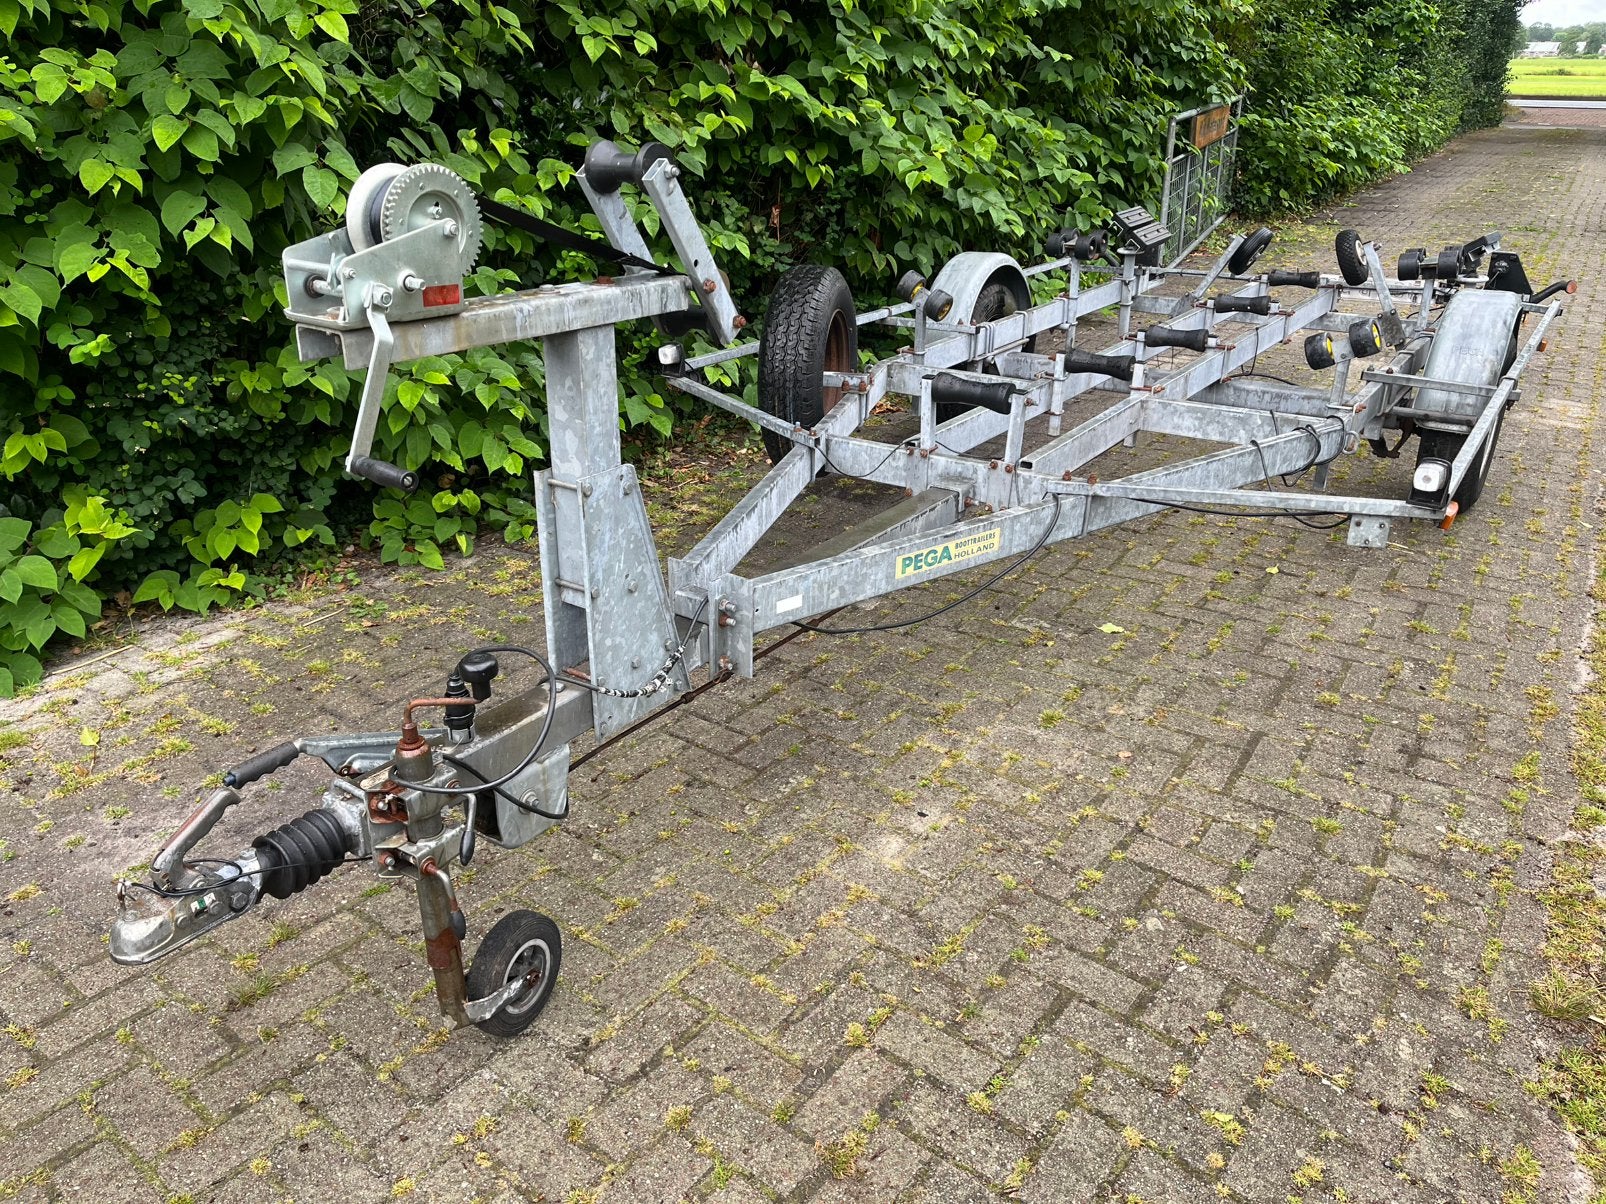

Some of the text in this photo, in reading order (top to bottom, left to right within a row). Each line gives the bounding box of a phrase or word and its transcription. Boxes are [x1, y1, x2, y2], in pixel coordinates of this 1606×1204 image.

[954, 531, 996, 549] BOOTTRAILERS
[954, 542, 995, 559] HOLLAND
[901, 546, 952, 574] PEGA
